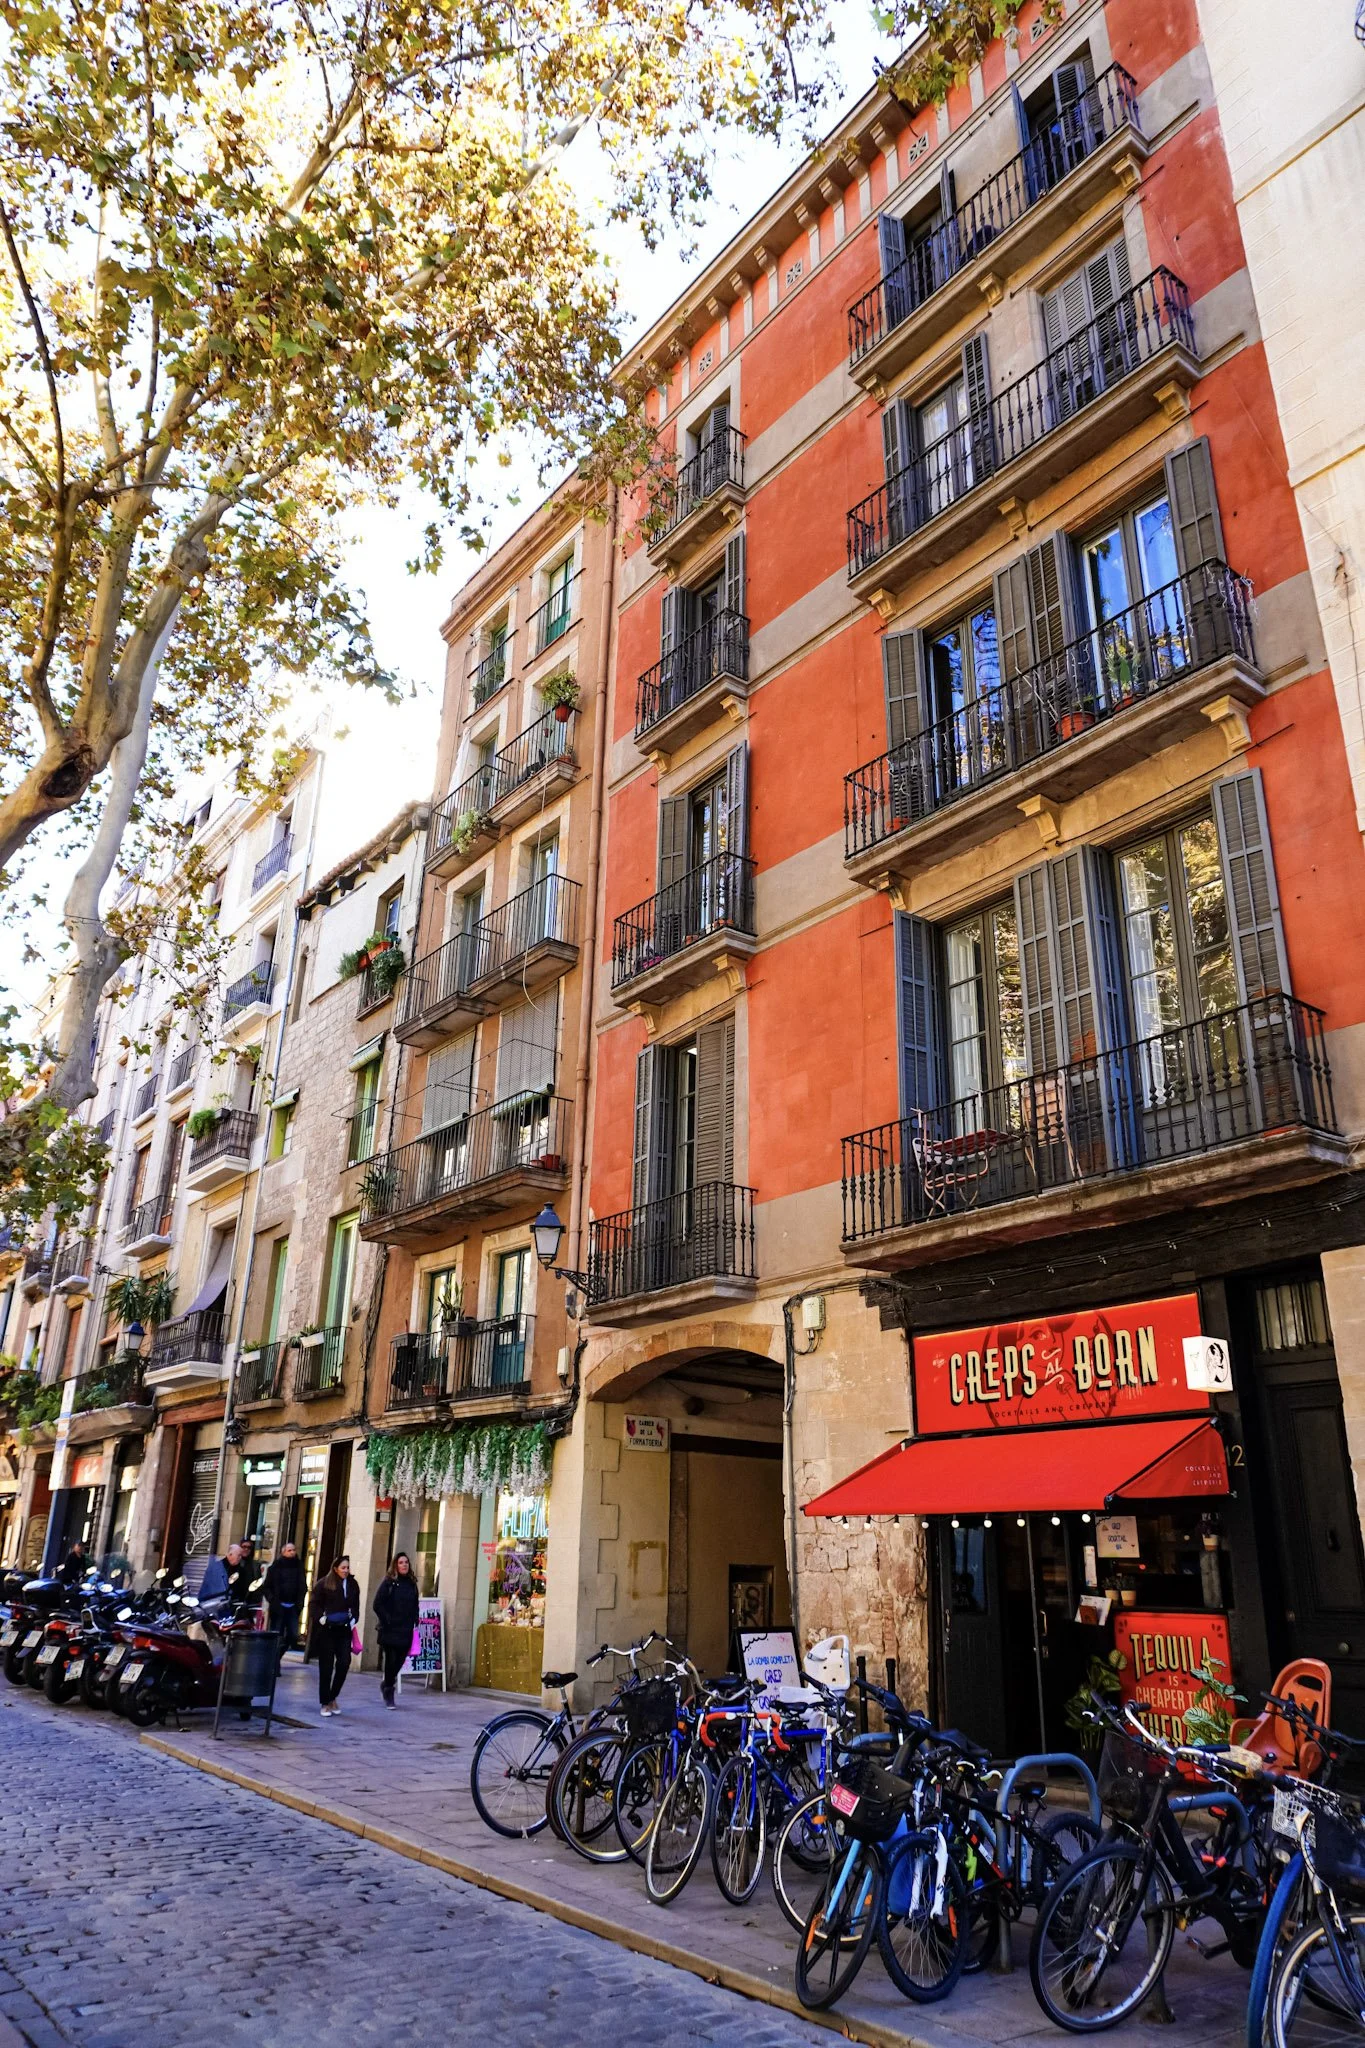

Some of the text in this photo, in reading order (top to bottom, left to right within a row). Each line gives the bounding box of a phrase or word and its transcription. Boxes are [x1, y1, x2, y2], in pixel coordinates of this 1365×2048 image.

[949, 1325, 1159, 1404] CREPS AL BORN
[415, 1660, 436, 1671] HERE
[1130, 1633, 1214, 1680] TEQUILA
[1168, 1675, 1179, 1687] IS
[1135, 1686, 1186, 1710] CHEAPER
